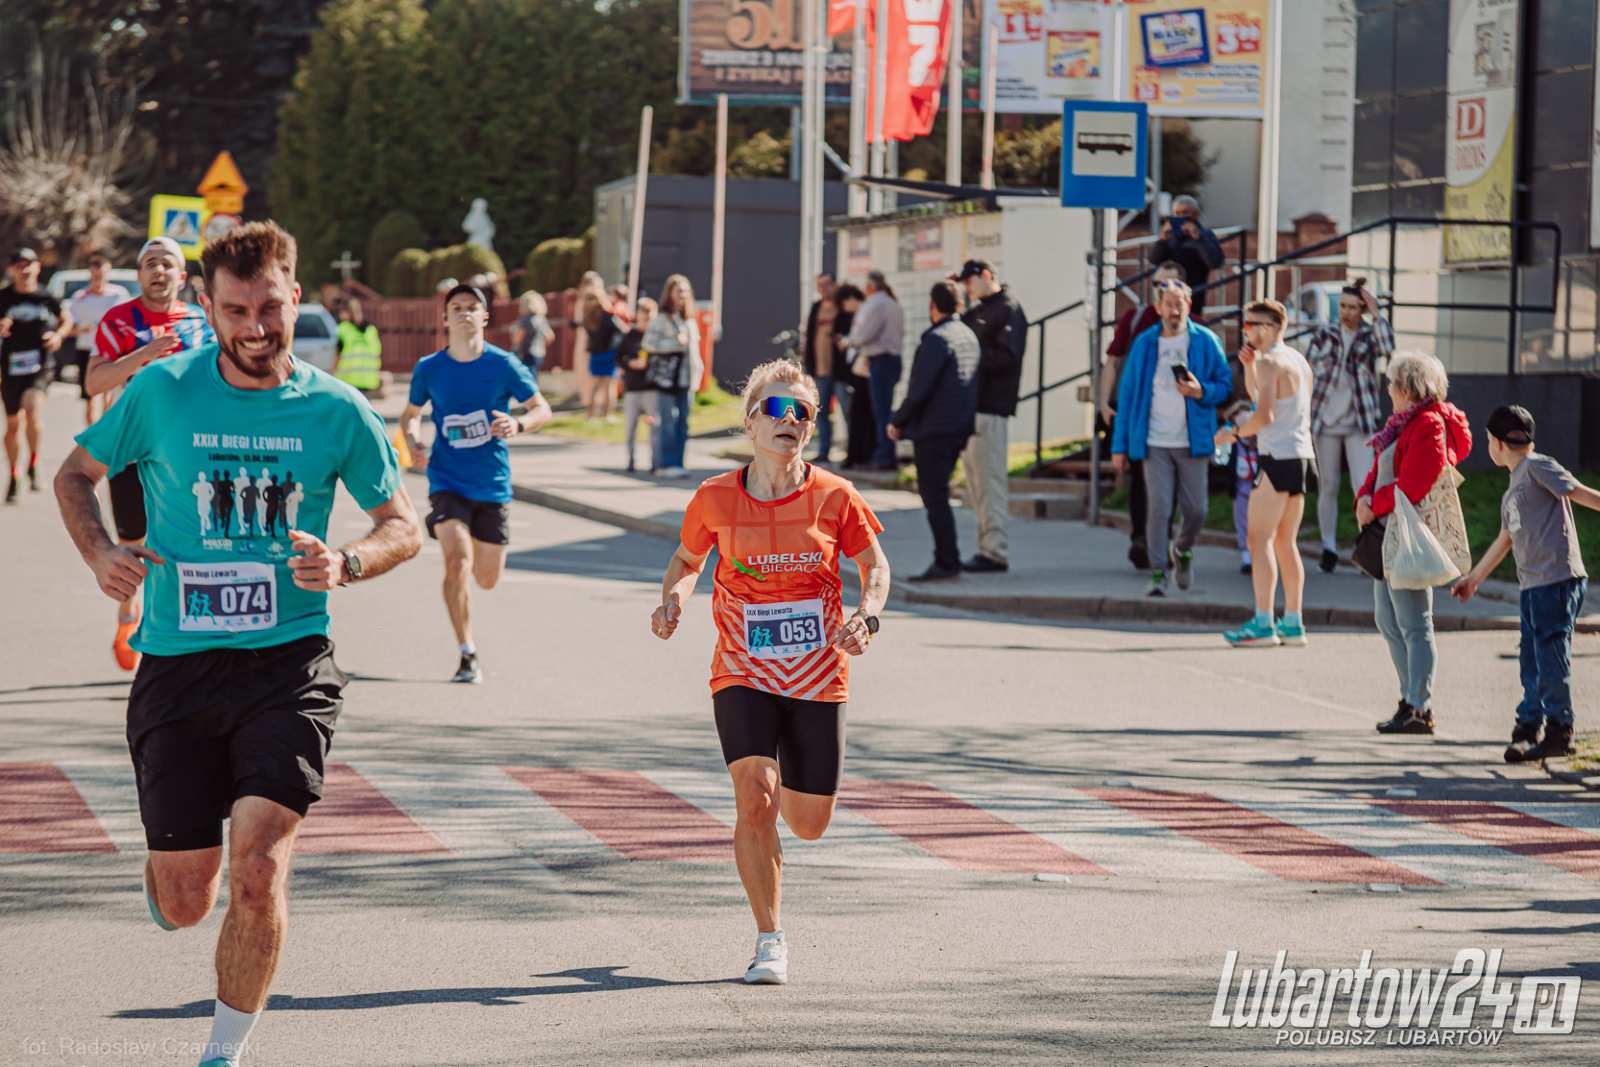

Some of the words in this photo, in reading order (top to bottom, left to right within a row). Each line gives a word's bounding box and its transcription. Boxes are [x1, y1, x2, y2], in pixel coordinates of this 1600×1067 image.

[193, 432, 218, 448] XXIX
[222, 434, 249, 449] BIEGI
[253, 436, 303, 452] LEWARTA
[747, 552, 823, 565] LUBELSKI
[761, 563, 820, 574] BIEGACZ
[220, 585, 268, 613] 074
[780, 618, 817, 643] 053
